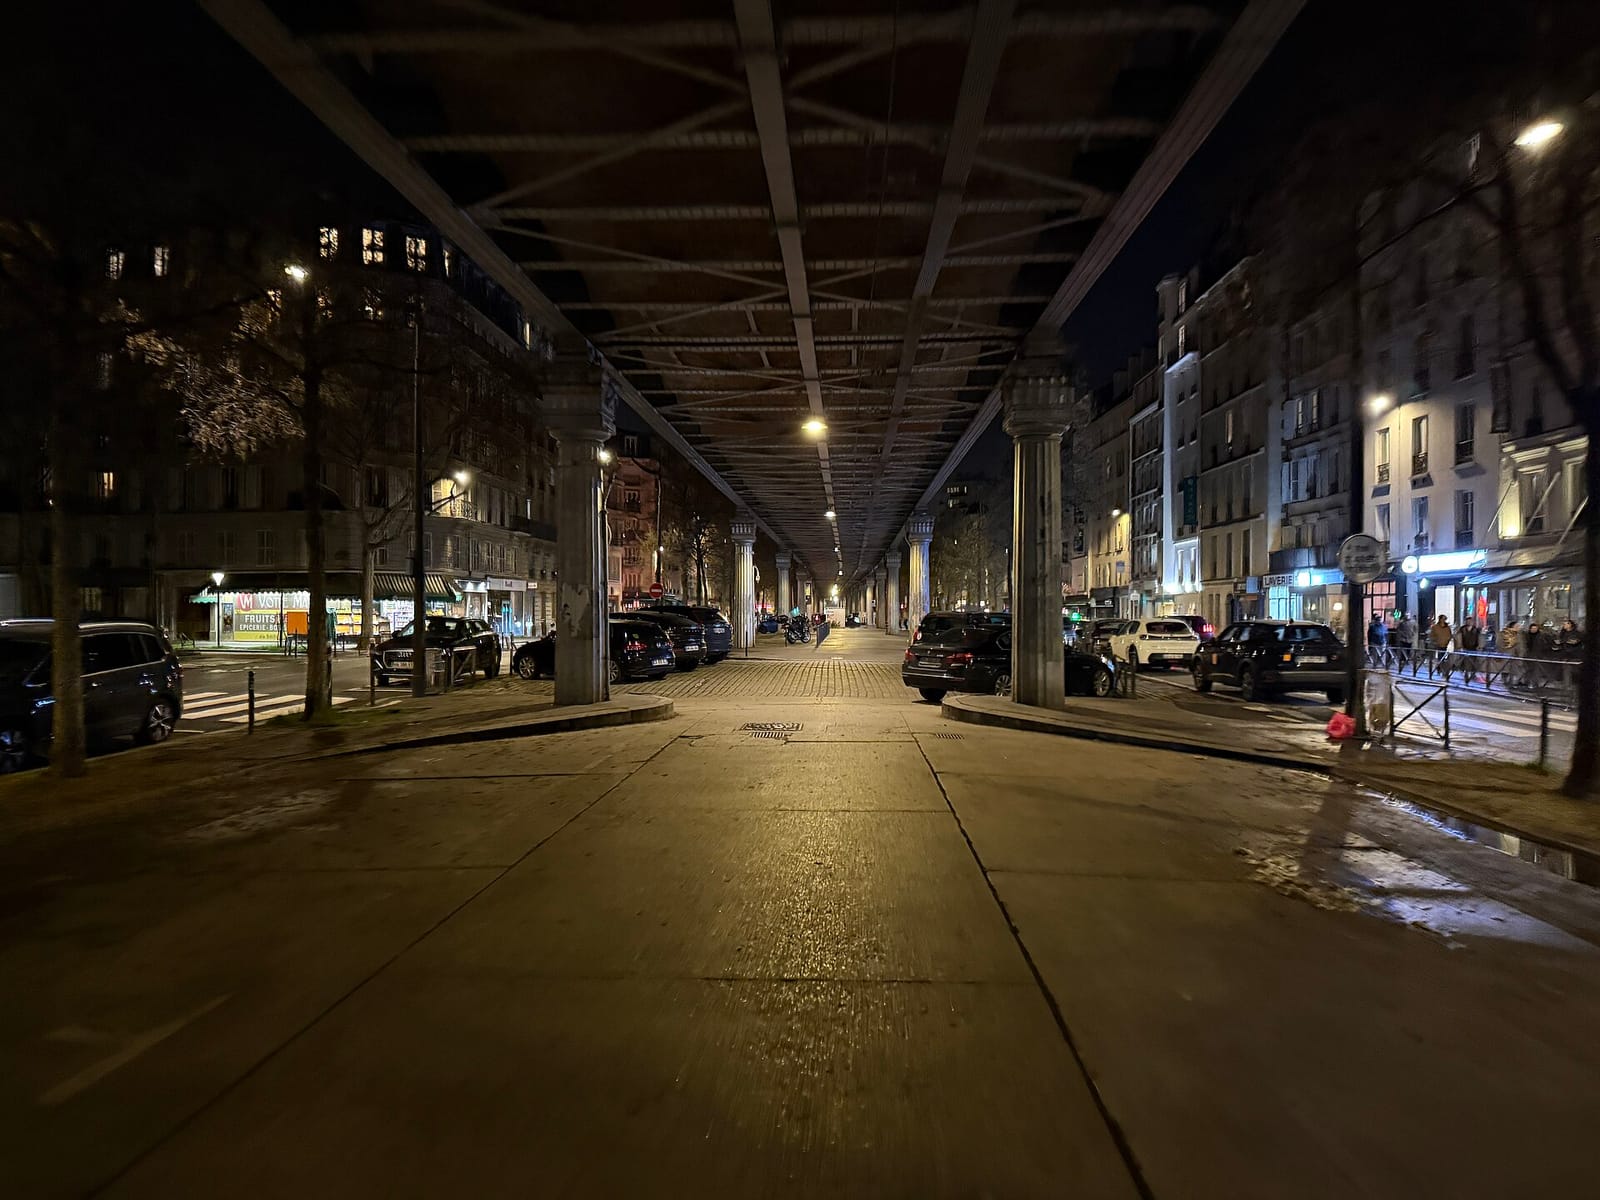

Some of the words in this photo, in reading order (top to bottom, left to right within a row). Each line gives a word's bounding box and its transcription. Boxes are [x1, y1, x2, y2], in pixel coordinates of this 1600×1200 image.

[1264, 575, 1293, 586] LAVERIE
[258, 594, 288, 609] VOTE
[245, 614, 276, 623] FRUITS
